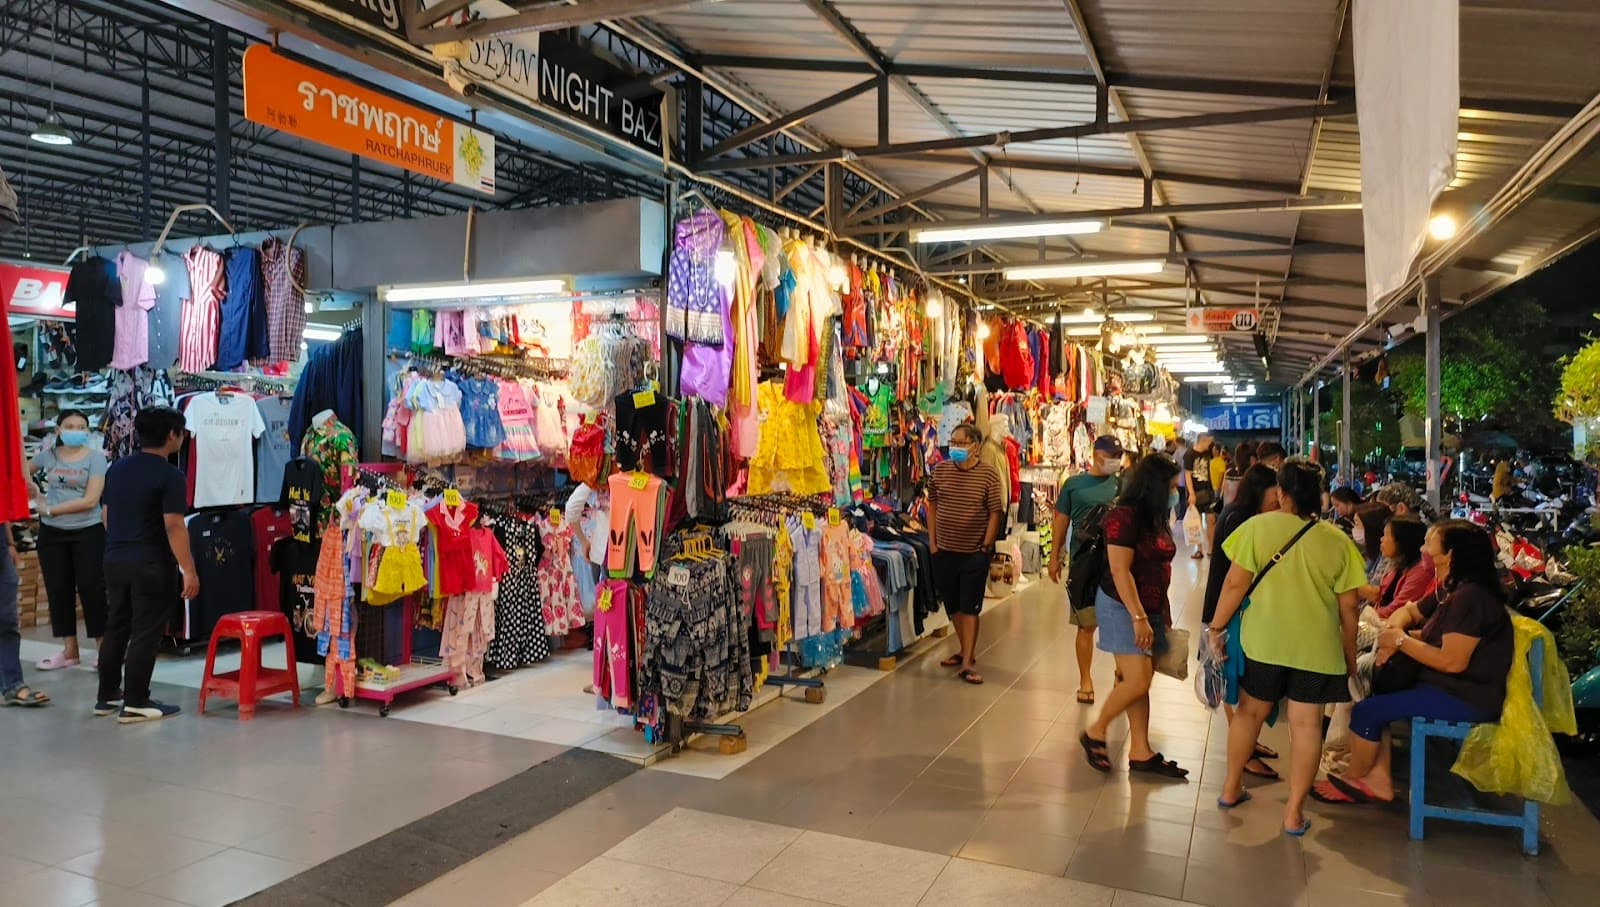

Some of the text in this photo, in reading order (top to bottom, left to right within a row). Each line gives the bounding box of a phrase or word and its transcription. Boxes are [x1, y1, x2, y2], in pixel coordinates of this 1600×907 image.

[542, 58, 613, 124] NIGHT
[621, 98, 661, 148] BAZ
[297, 80, 443, 154] ราชพฤกษ์
[366, 138, 452, 177] RATCHAPHRUEK
[389, 495, 402, 505] 100
[446, 494, 457, 503] 100
[673, 571, 688, 583] 100
